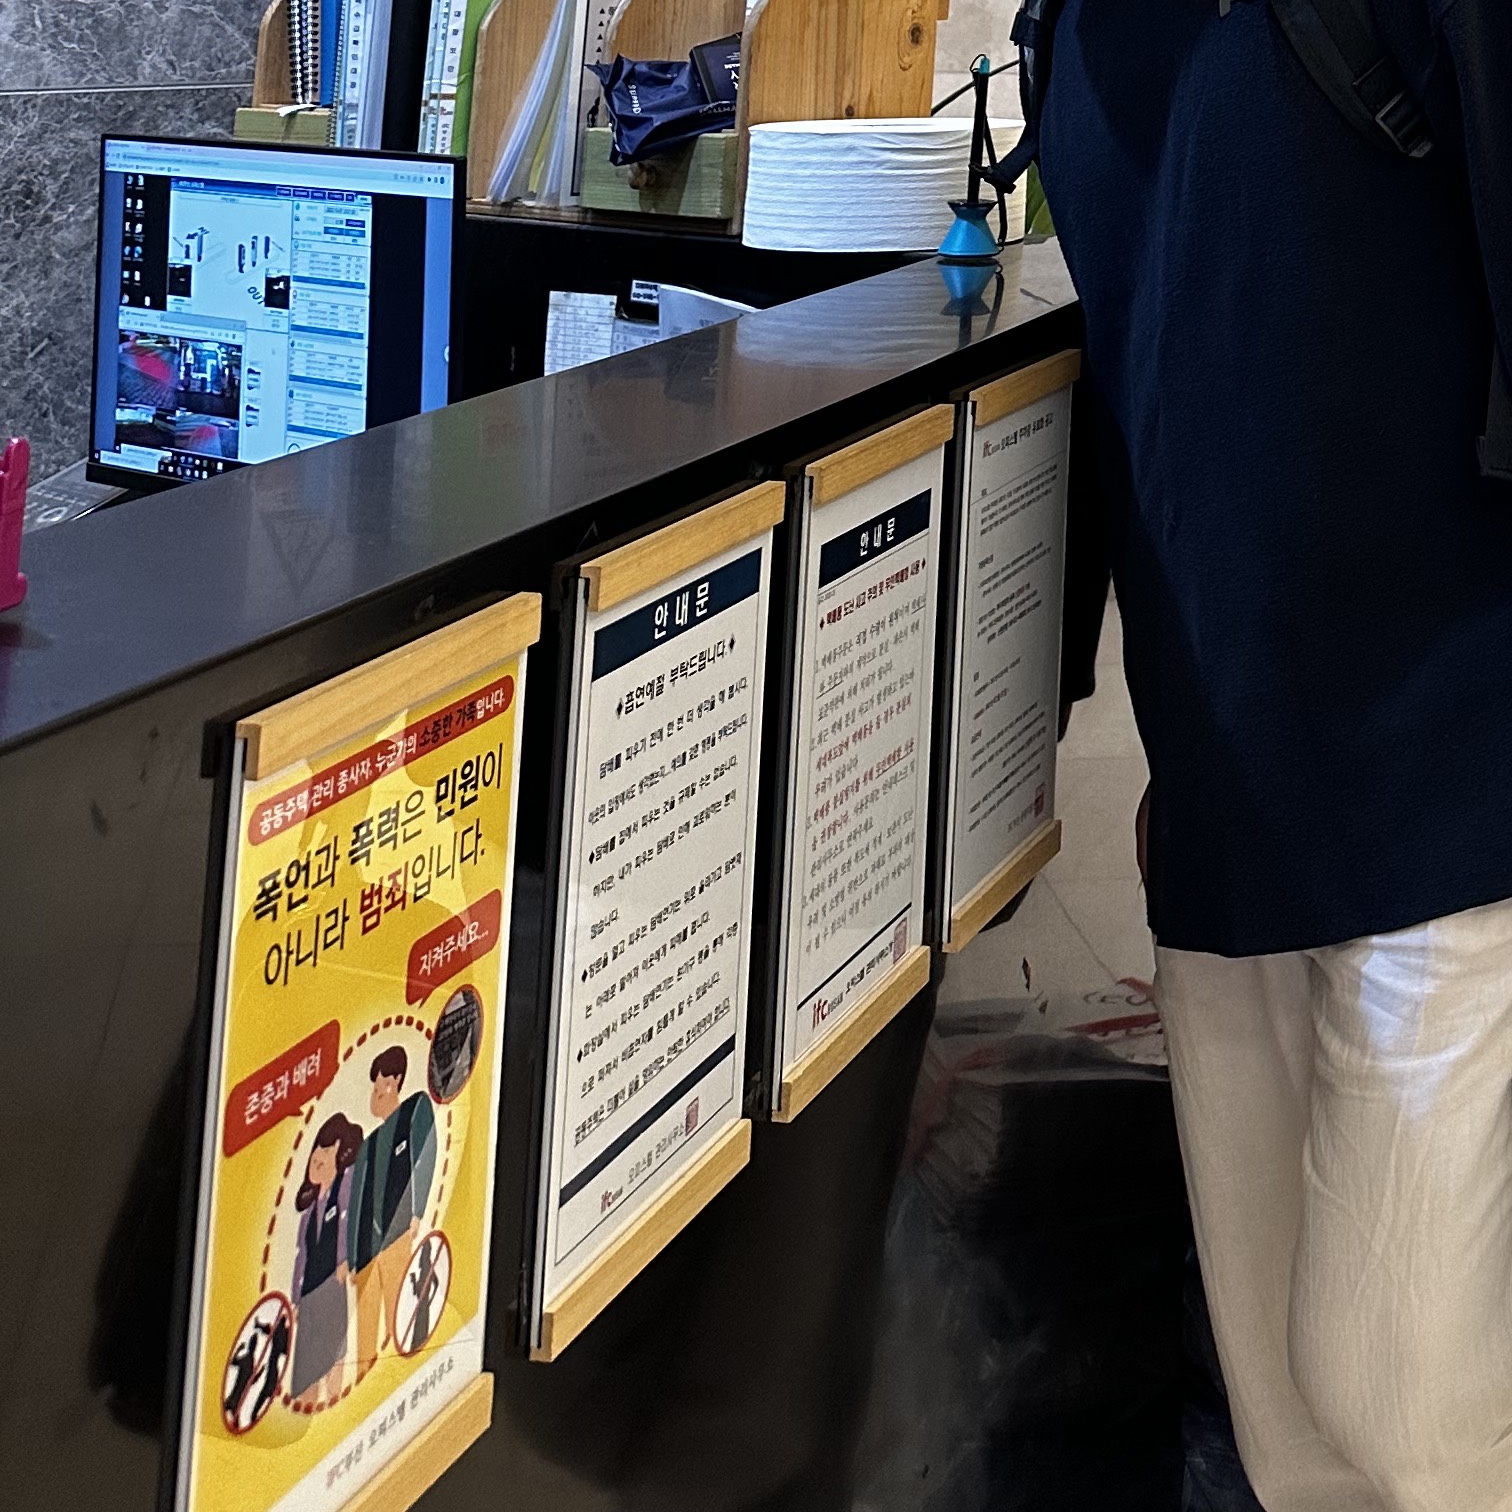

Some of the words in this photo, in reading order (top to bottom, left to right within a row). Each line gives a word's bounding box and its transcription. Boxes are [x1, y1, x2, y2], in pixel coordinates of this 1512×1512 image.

[623, 674, 665, 714] 흡연예절
[669, 640, 725, 685] 부탁드립니다.
[260, 789, 310, 836] 공동주택
[311, 777, 335, 810] 관리
[375, 735, 418, 771] 누군가의
[420, 716, 453, 747] 소중한
[598, 753, 622, 778] 담배를
[624, 737, 647, 760] 피우기
[648, 727, 664, 747] 전에
[685, 708, 694, 722] 더
[253, 836, 340, 922] 폭언과
[349, 790, 424, 866] 폭력은
[434, 743, 503, 824] 민원이
[264, 899, 350, 986] 아니라
[359, 817, 485, 935] 범죄입니다.
[244, 1071, 292, 1125] 존중과
[293, 1048, 322, 1091] 배려
[368, 1398, 406, 1449] 오피스텔
[410, 1356, 455, 1411] 관리사무소
